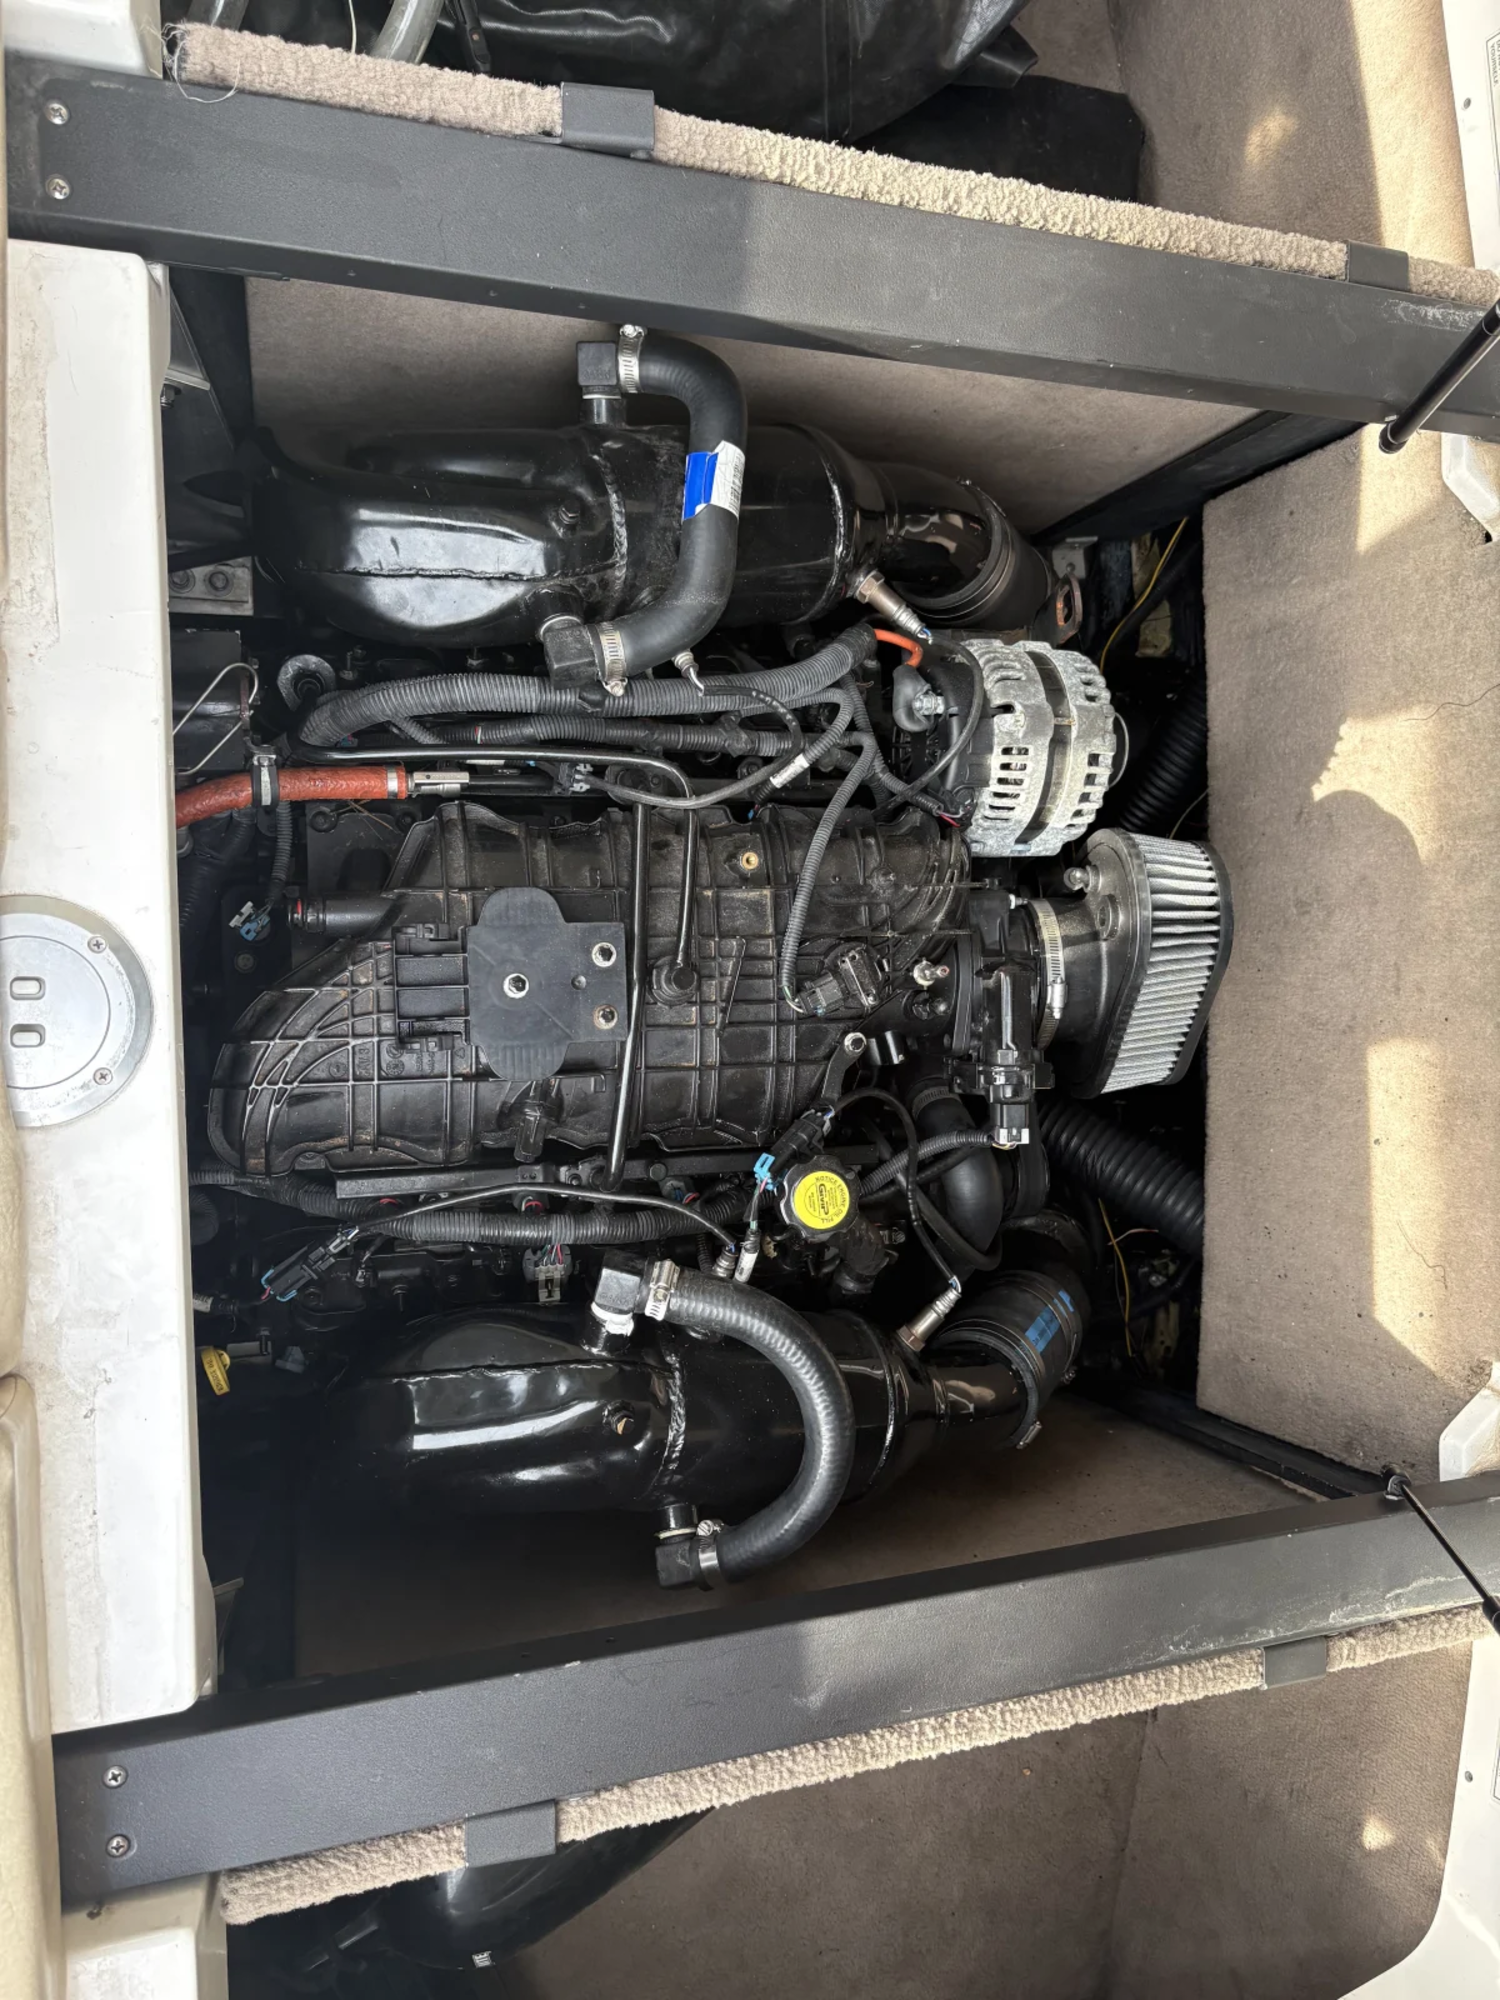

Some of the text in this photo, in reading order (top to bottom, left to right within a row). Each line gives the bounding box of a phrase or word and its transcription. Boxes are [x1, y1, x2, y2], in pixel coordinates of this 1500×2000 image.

[815, 1176, 838, 1186] NOTICE
[836, 1184, 846, 1208] ENGINE
[834, 1208, 844, 1218] OIL
